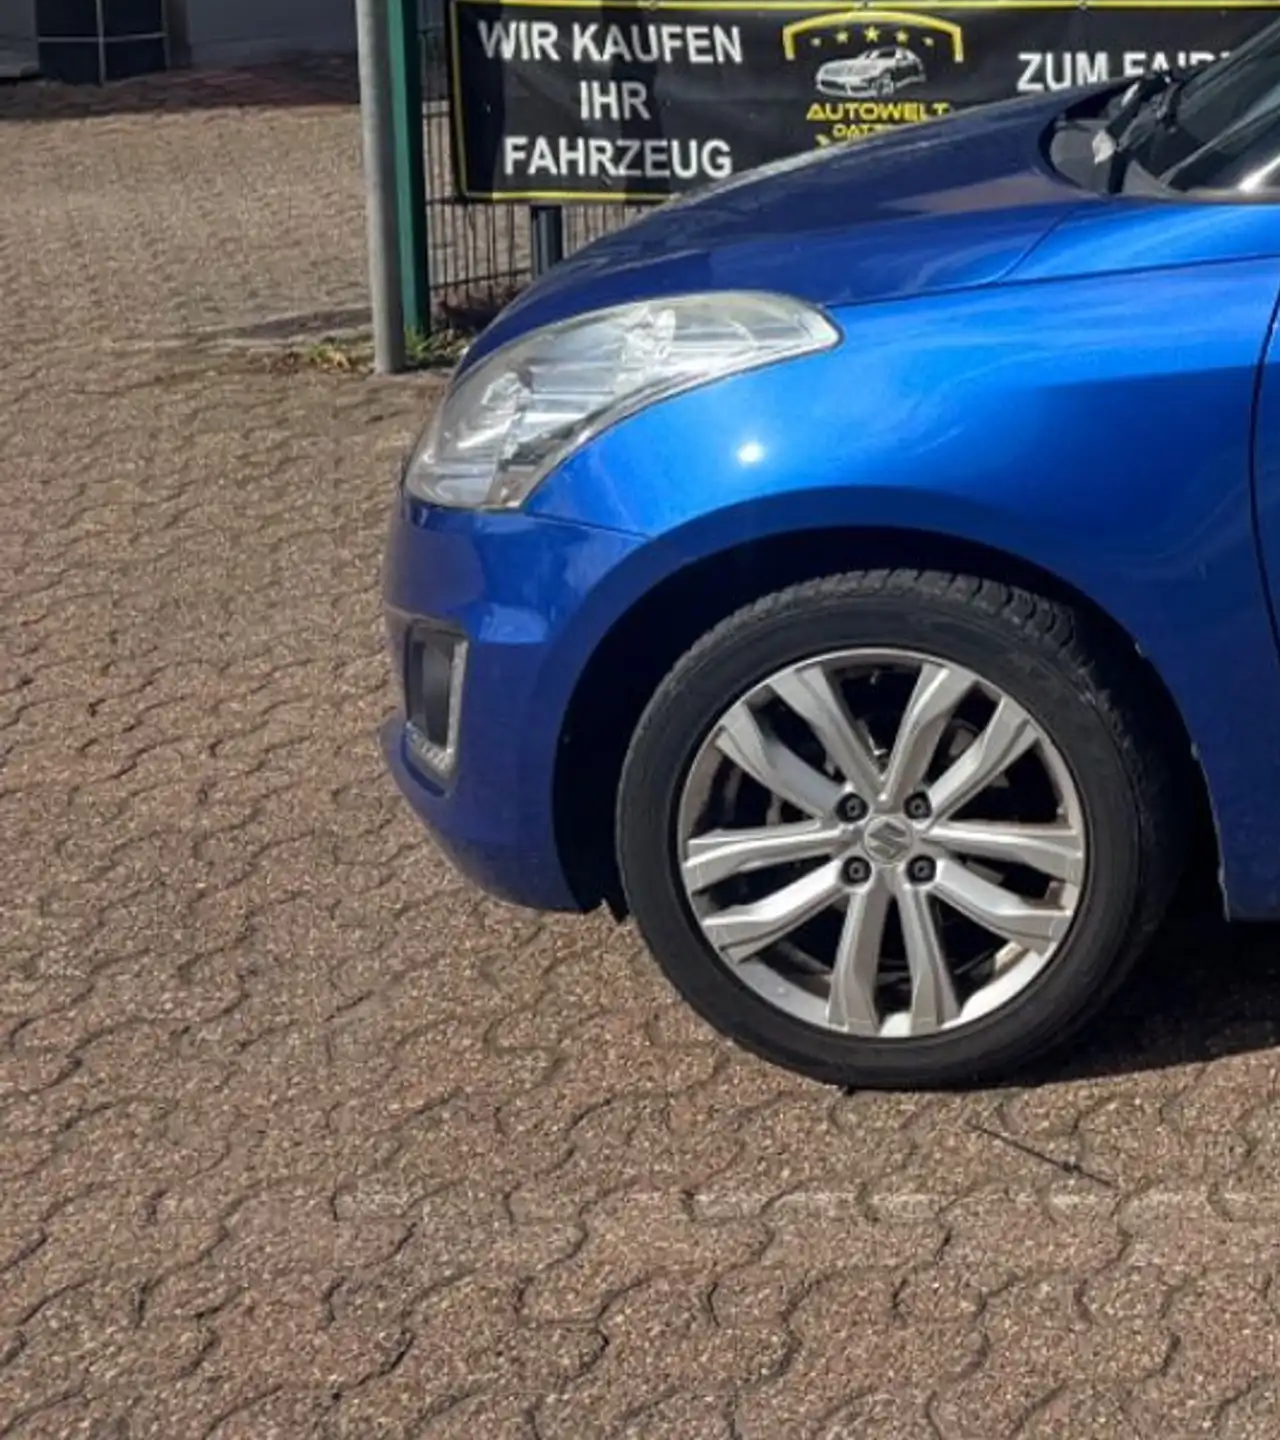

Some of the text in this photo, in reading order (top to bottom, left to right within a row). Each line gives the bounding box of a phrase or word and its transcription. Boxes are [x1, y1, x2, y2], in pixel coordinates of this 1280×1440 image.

[477, 20, 743, 64] WIR KAUFEN
[1017, 51, 1108, 92] ZUM
[579, 80, 651, 121] IHR
[805, 101, 950, 122] AUTOWELT
[503, 135, 733, 178] FAHRZEUG
